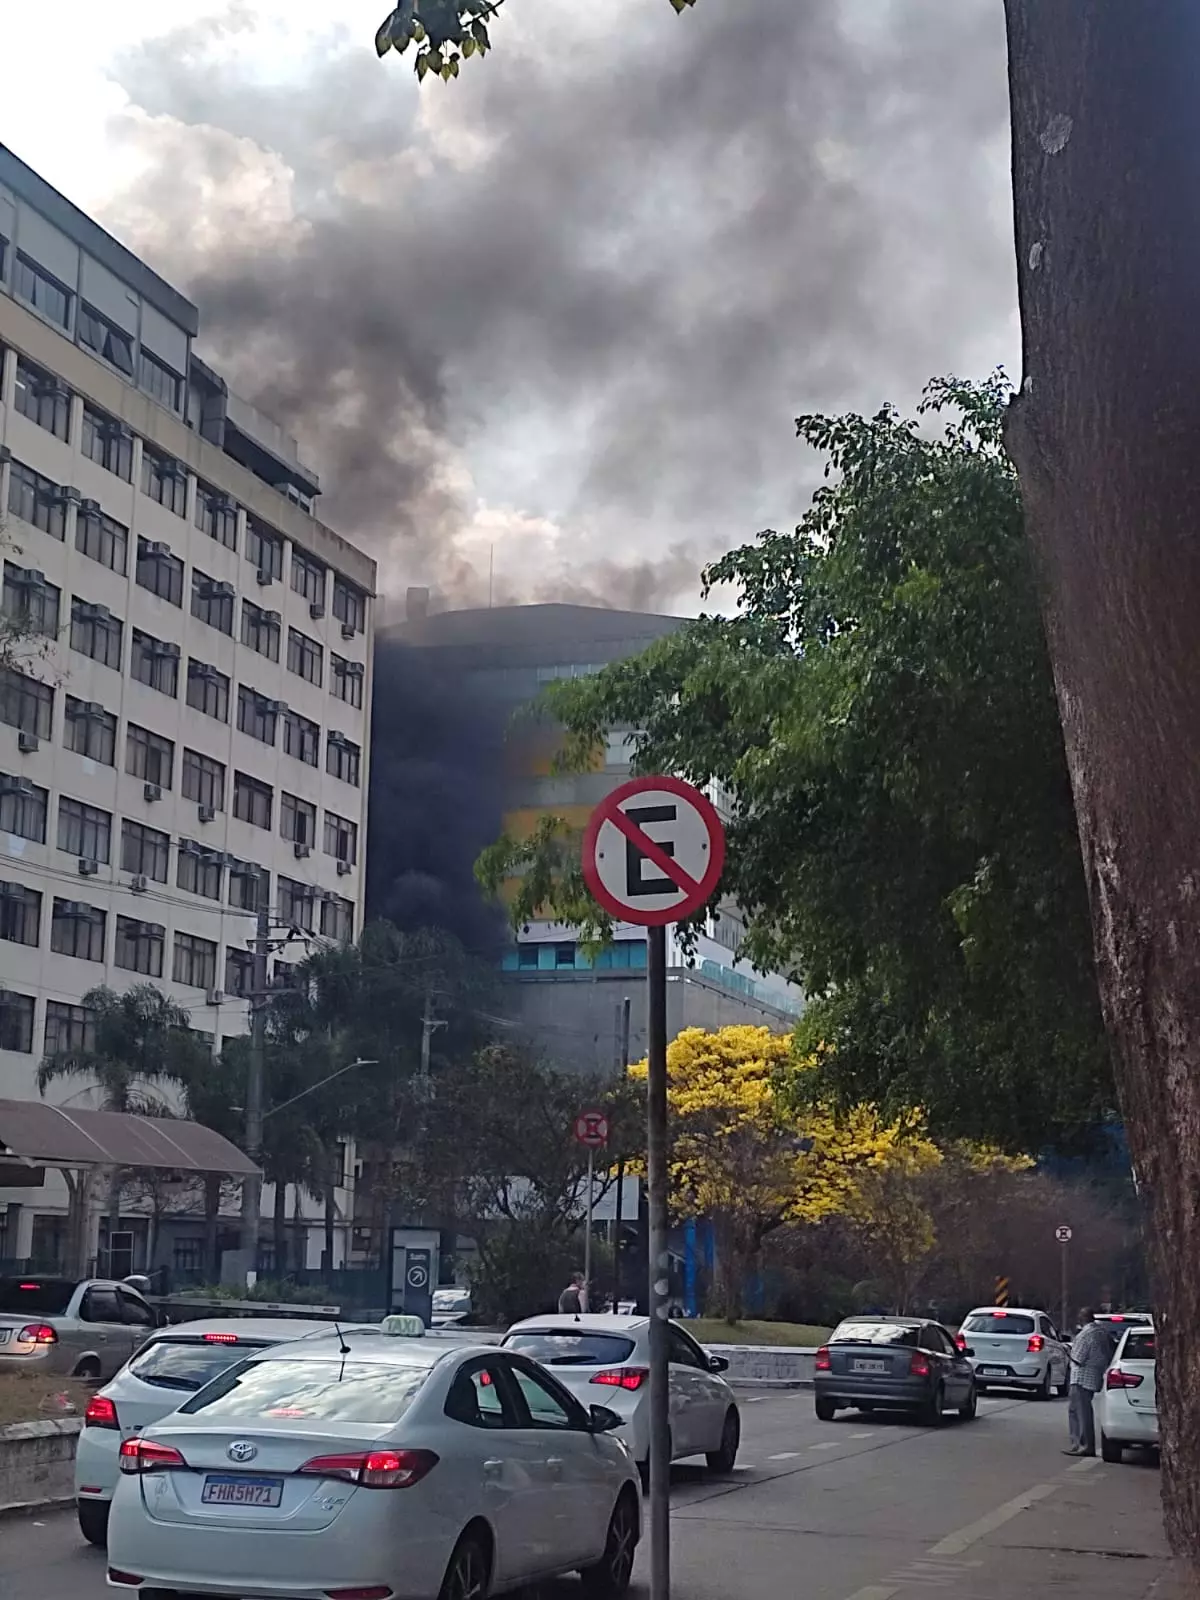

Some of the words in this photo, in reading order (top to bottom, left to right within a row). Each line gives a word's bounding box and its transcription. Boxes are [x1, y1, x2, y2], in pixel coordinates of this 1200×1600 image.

[625, 805, 679, 896] E
[386, 1318, 417, 1333] TAXI
[207, 1484, 272, 1503] FHR5H71
